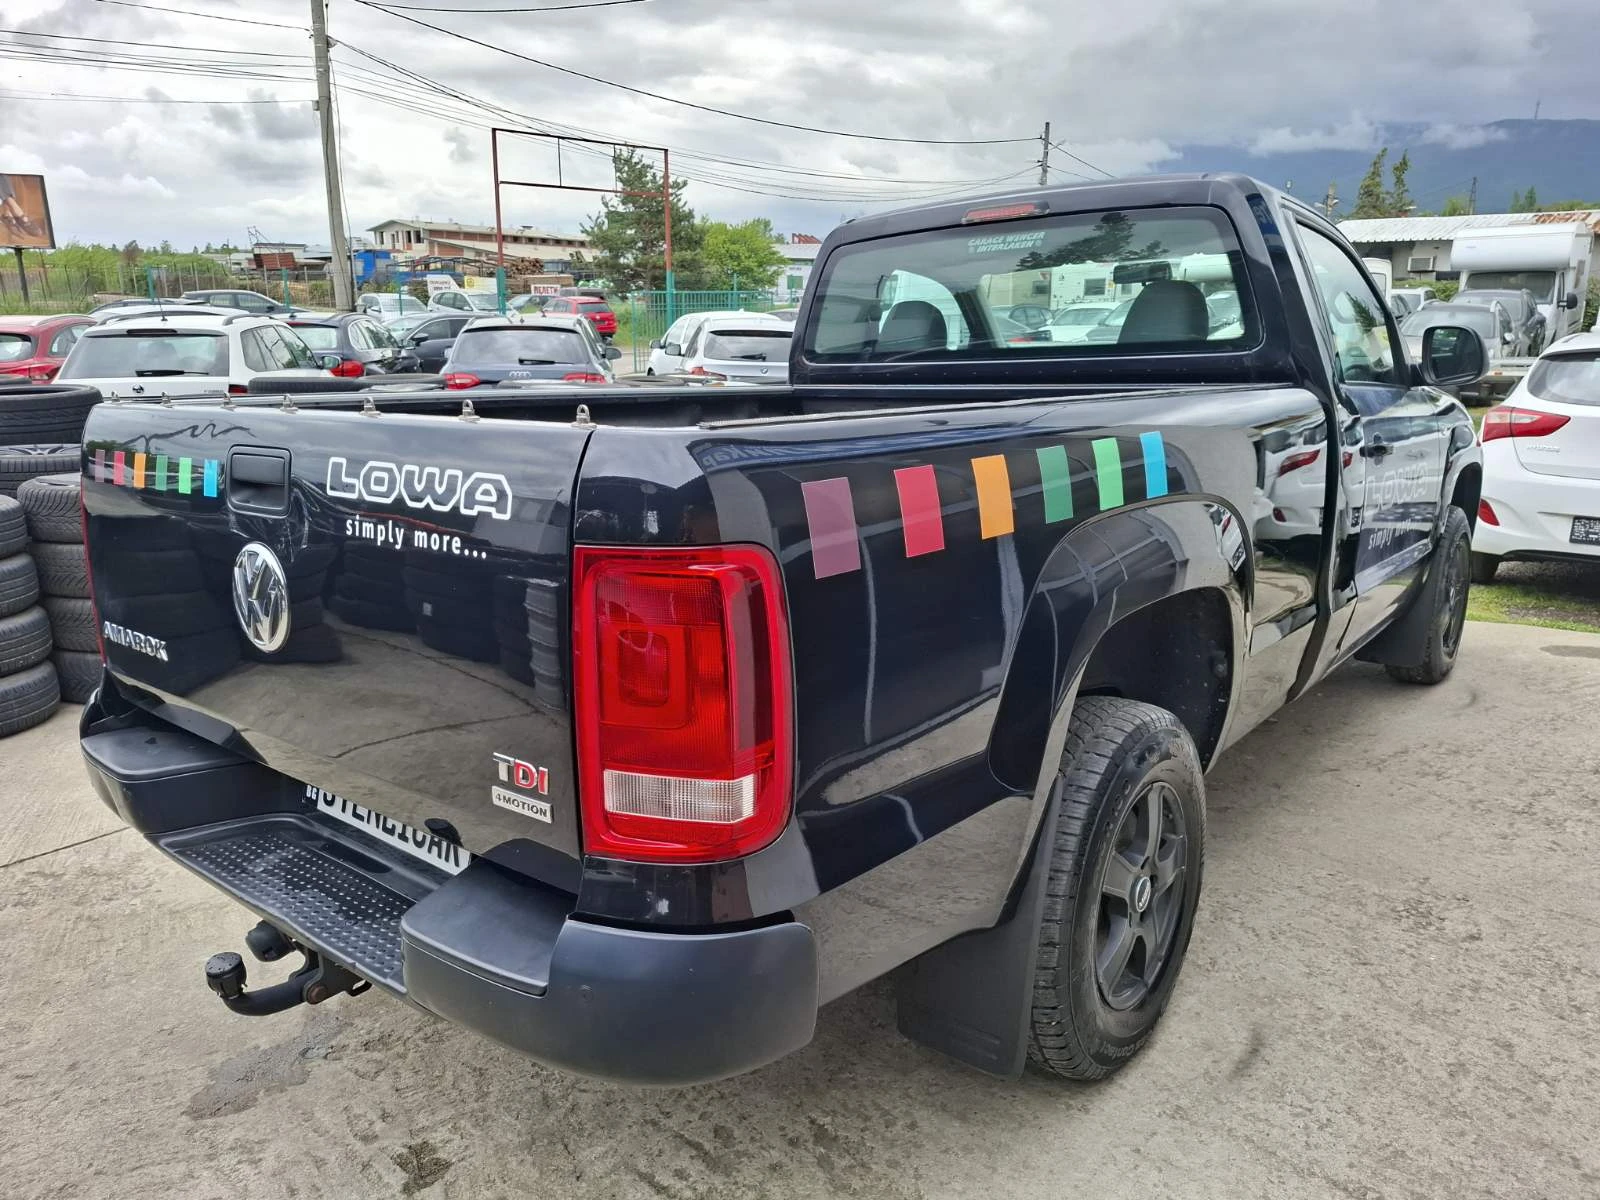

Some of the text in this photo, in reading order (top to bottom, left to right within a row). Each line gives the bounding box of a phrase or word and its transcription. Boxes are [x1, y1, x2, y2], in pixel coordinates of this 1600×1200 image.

[326, 456, 513, 521] LOWA
[345, 514, 487, 560] simply more...
[103, 620, 169, 661] AMAROK
[493, 751, 549, 796] TDI
[495, 793, 548, 818] 4MOTION
